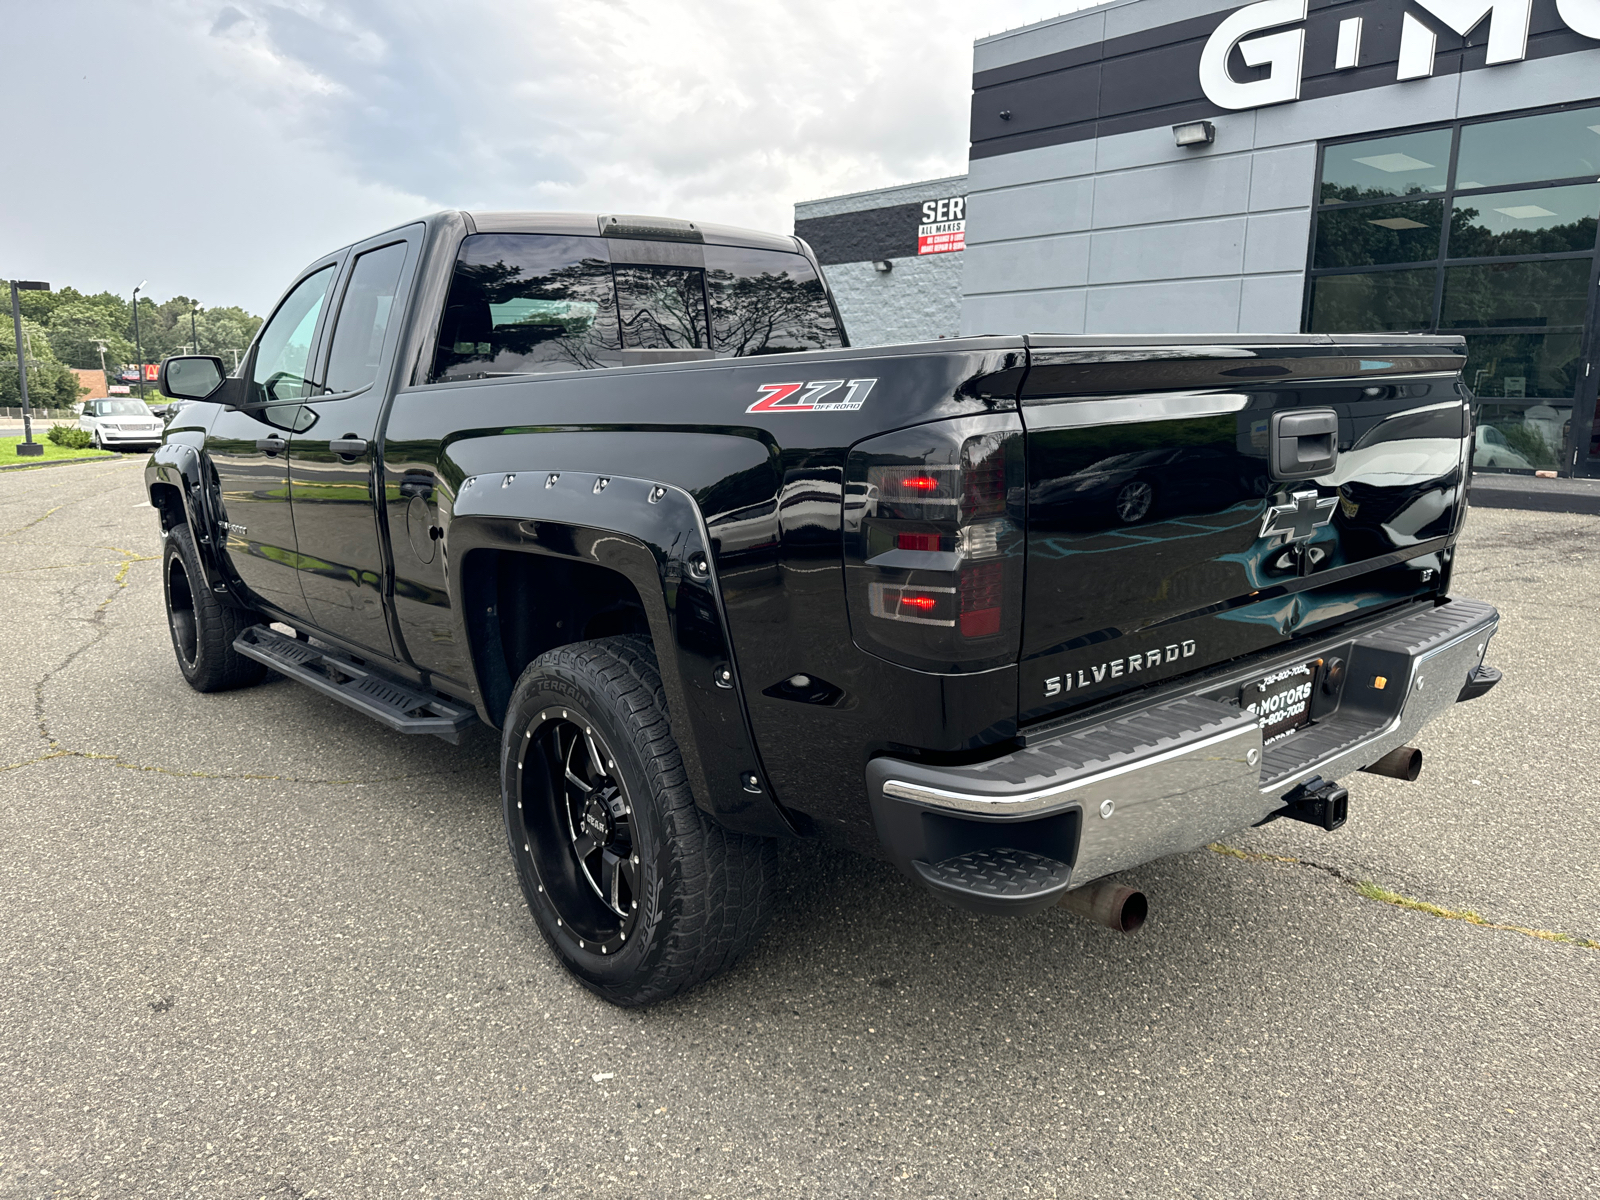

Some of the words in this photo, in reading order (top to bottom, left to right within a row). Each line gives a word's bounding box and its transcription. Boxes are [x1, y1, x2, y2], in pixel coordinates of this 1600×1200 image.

[922, 196, 967, 224] SER
[921, 226, 933, 236] ALL
[935, 223, 961, 234] MAKES
[745, 377, 878, 414] Z71
[833, 402, 861, 410] ROAD
[1043, 639, 1197, 698] SILVERADO
[1258, 701, 1306, 729] 2-800-7003
[637, 863, 654, 954] COOPER
